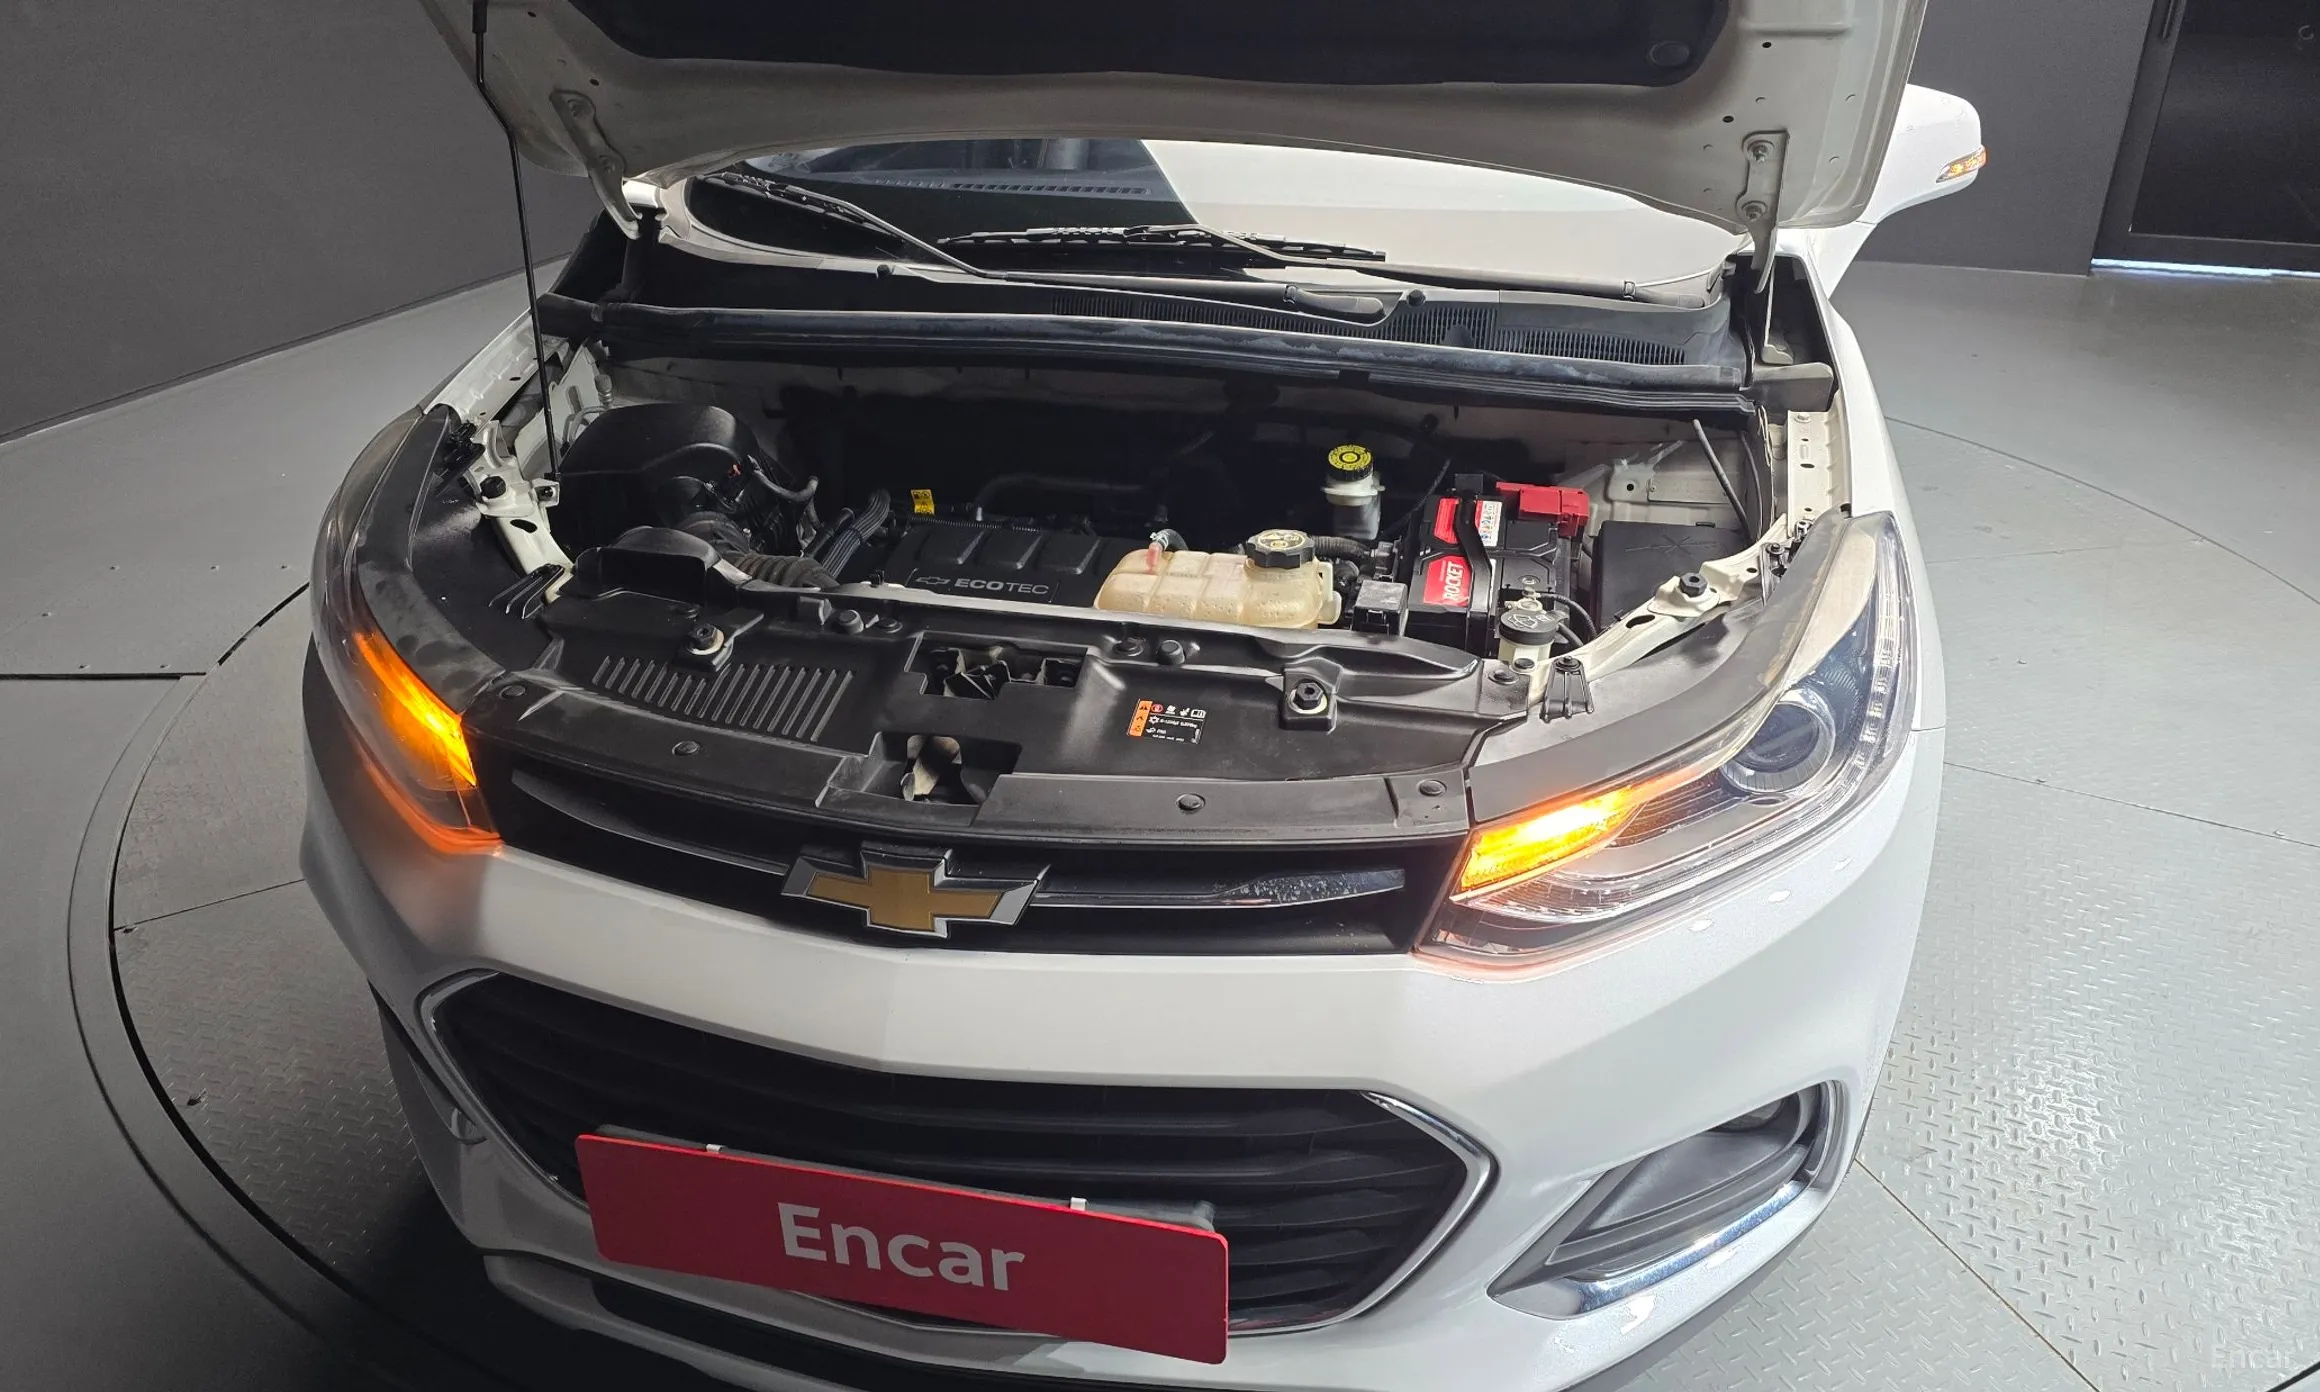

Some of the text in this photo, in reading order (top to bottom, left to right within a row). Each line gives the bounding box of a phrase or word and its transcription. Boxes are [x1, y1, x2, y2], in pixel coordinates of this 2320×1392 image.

[954, 578, 1049, 595] ECOTEC
[1443, 560, 1464, 601] ROCKET
[777, 1201, 1026, 1291] Encar
